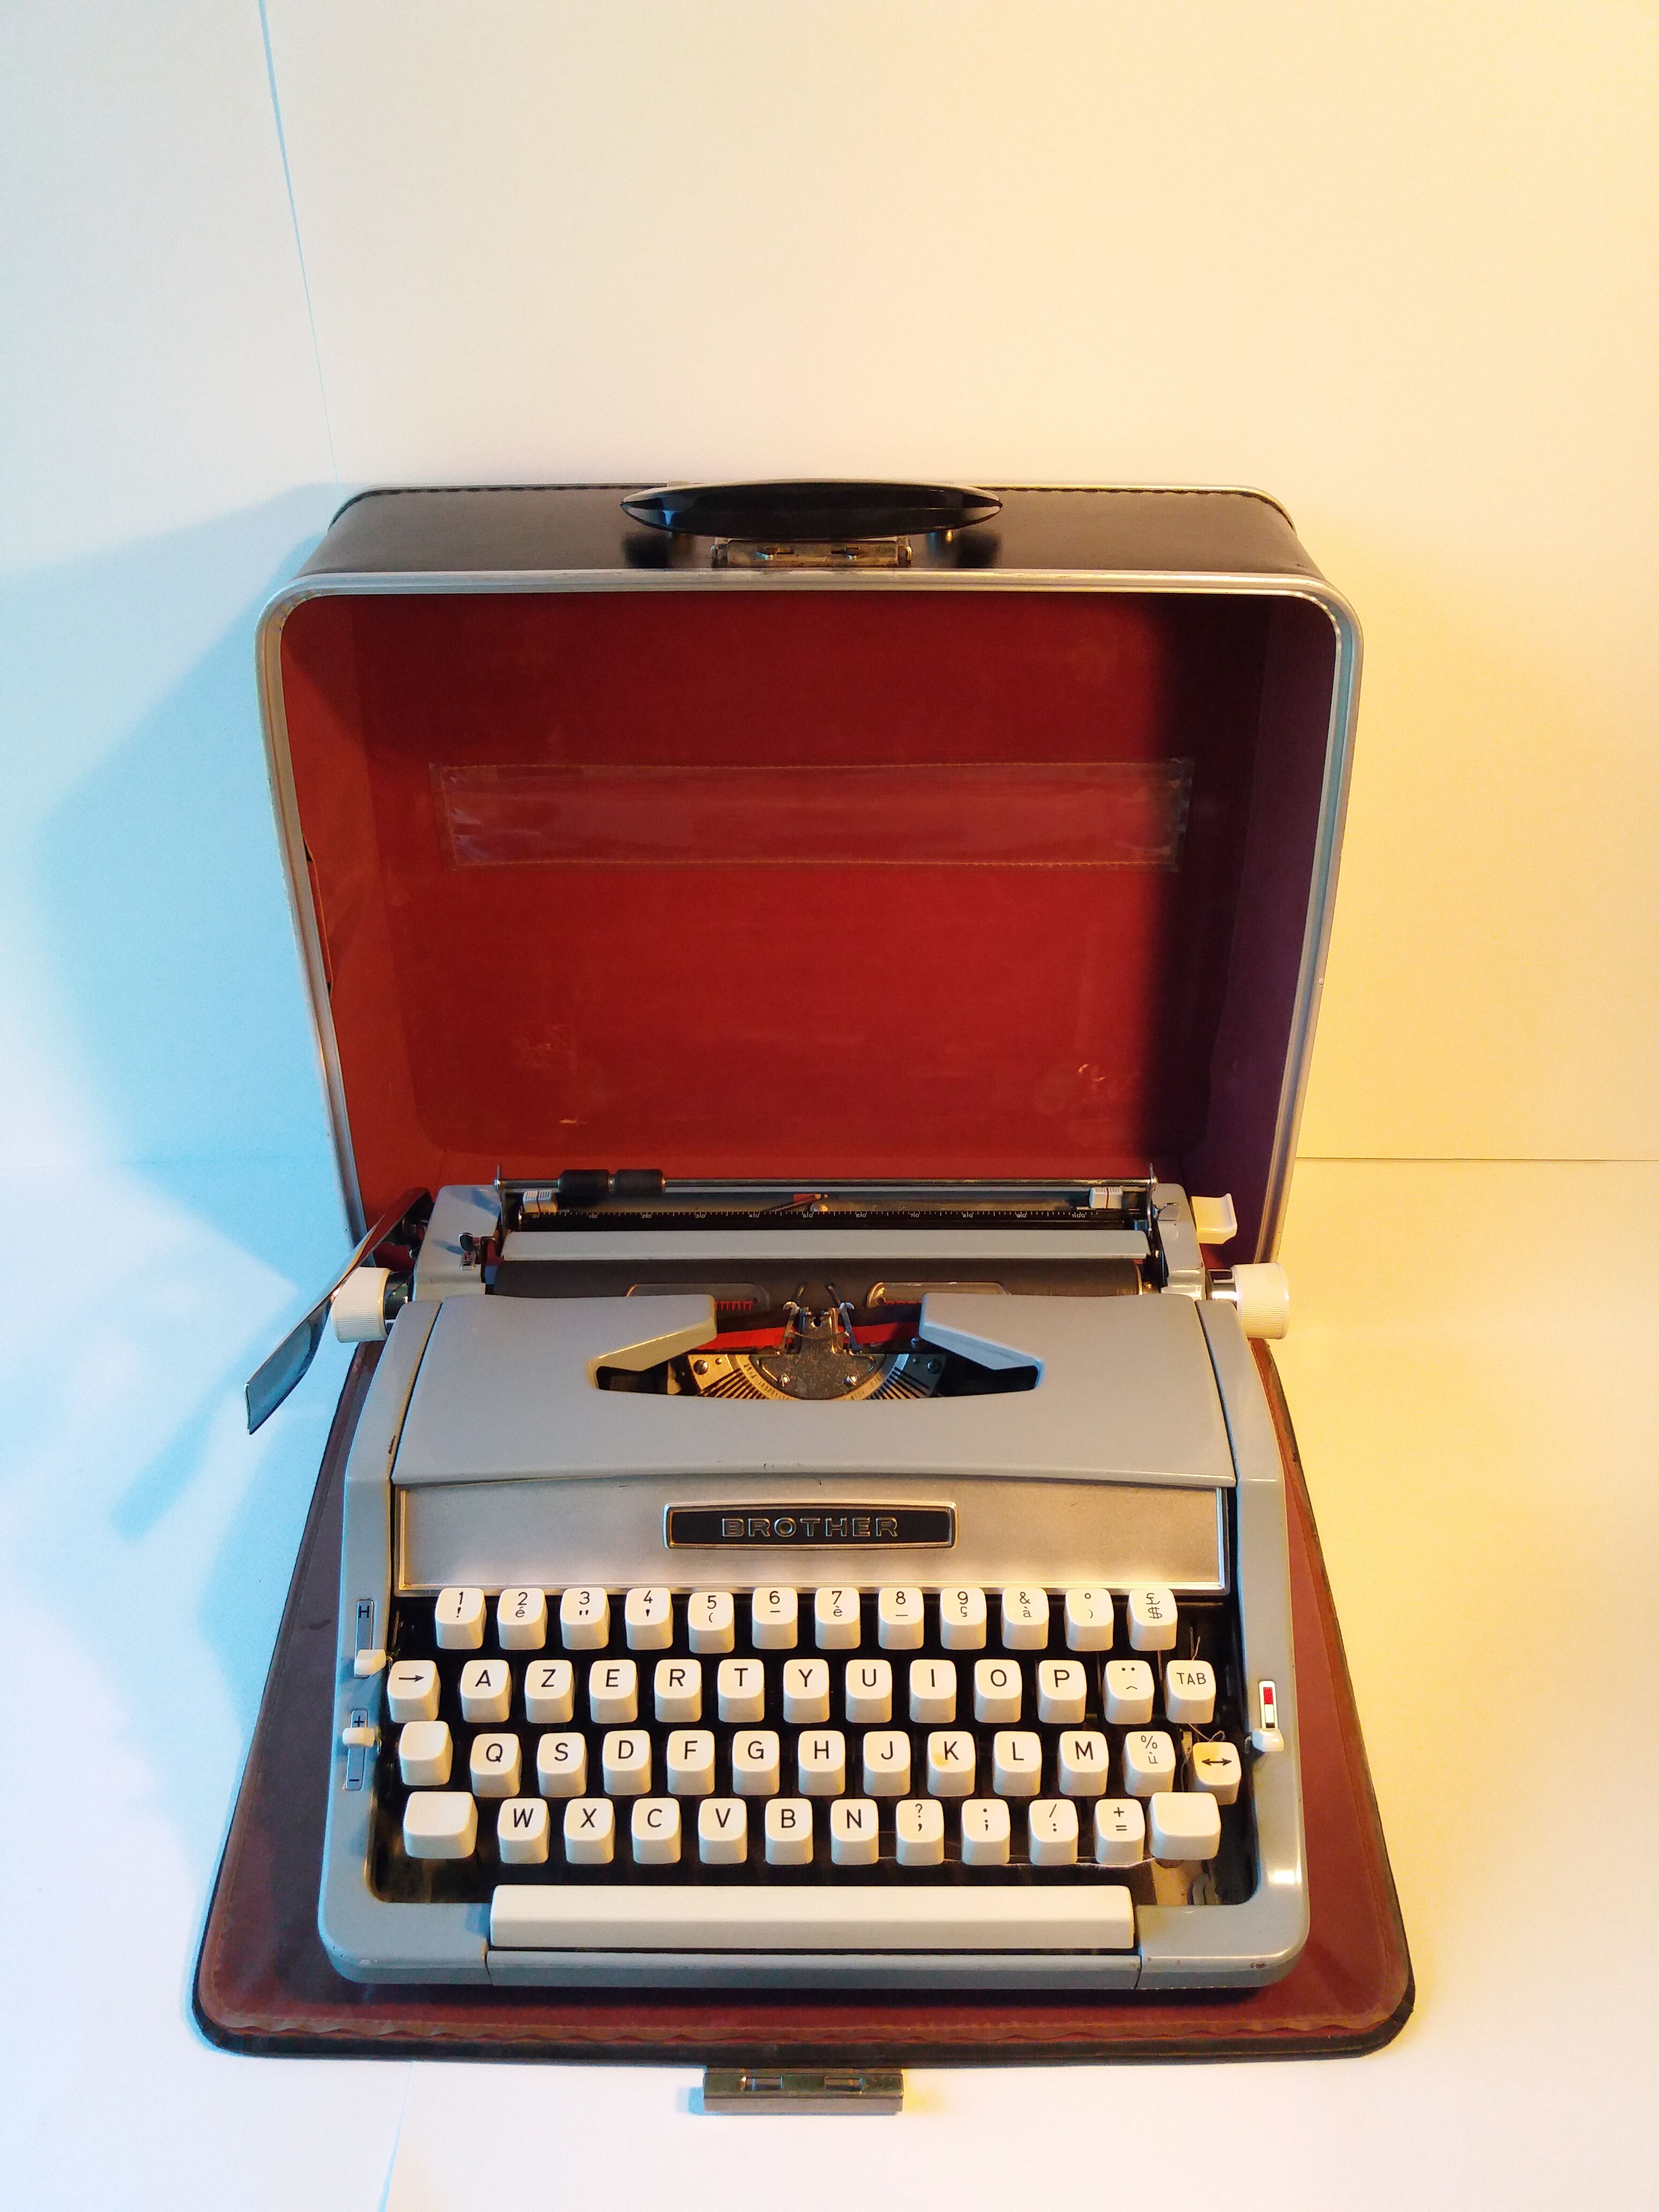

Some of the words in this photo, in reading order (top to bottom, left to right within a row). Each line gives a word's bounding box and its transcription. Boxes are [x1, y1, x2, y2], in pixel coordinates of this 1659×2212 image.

[722, 1517, 899, 1537] BROTHER
[459, 1591, 464, 1605] 1
[518, 1591, 528, 1605] 2
[579, 1591, 590, 1605] 3
[643, 1590, 653, 1604] 4
[707, 1595, 717, 1609] 5
[769, 1590, 780, 1604] 6
[832, 1590, 842, 1605] 7
[895, 1591, 906, 1605] 8
[957, 1591, 968, 1605] 9
[1019, 1591, 1031, 1604] &
[358, 1605, 370, 1618] H
[456, 1606, 461, 1618] !
[515, 1606, 525, 1618] é
[833, 1605, 842, 1617] è
[1148, 1606, 1163, 1619] $
[475, 1670, 491, 1687] A
[541, 1669, 556, 1687] Z
[606, 1669, 620, 1687] E
[669, 1669, 686, 1687] R
[734, 1668, 749, 1687] T
[798, 1669, 813, 1687] Y
[862, 1669, 877, 1687] U
[931, 1669, 935, 1687] I
[990, 1669, 1007, 1687] O
[1053, 1669, 1070, 1688] P
[1176, 1672, 1206, 1685] TAB
[618, 1740, 634, 1759] D
[684, 1740, 698, 1760] F
[748, 1740, 764, 1759] G
[814, 1740, 829, 1760] H
[881, 1740, 893, 1760] J
[944, 1741, 959, 1760] K
[1075, 1740, 1094, 1760] M
[1140, 1735, 1157, 1749] %
[486, 1743, 503, 1762] Q
[554, 1742, 569, 1761] S
[1012, 1742, 1025, 1761] L
[1148, 1751, 1159, 1764] ù
[513, 1808, 534, 1828] W
[580, 1808, 597, 1828] X
[647, 1809, 662, 1828] C
[715, 1808, 731, 1828] V
[781, 1809, 796, 1828] B
[847, 1809, 862, 1829] N
[915, 1803, 923, 1818] ?
